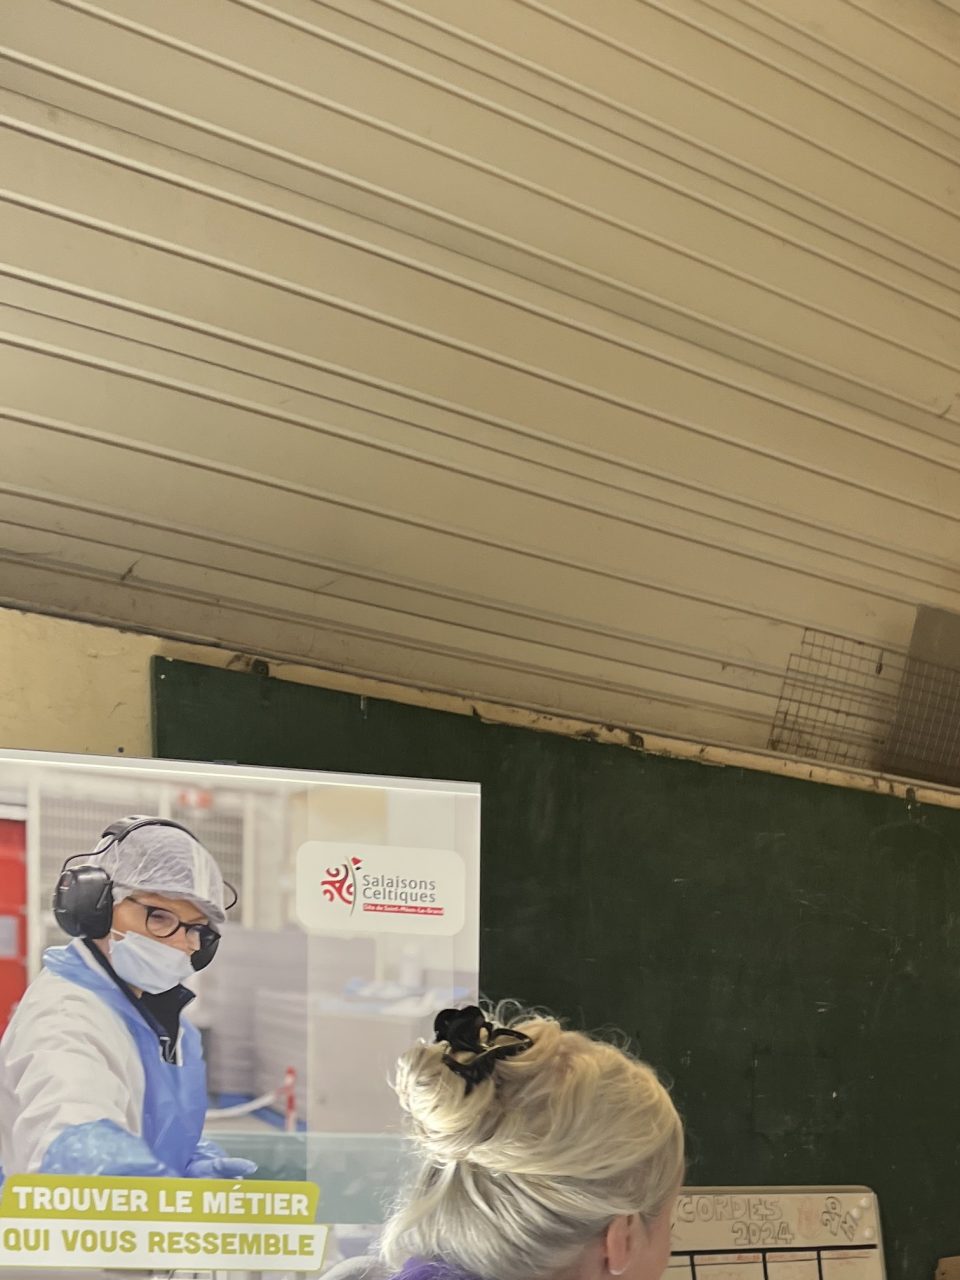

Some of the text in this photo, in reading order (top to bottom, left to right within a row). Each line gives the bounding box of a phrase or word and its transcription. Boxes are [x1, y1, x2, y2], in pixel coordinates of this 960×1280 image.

[362, 874, 436, 891] Salaisons
[362, 887, 436, 904] Celtiques
[12, 1184, 309, 1216] TROUVER LE MÉTIER
[3, 1227, 316, 1257] QUI VOUS RESSEMBLE
[731, 1220, 795, 1247] 2024
